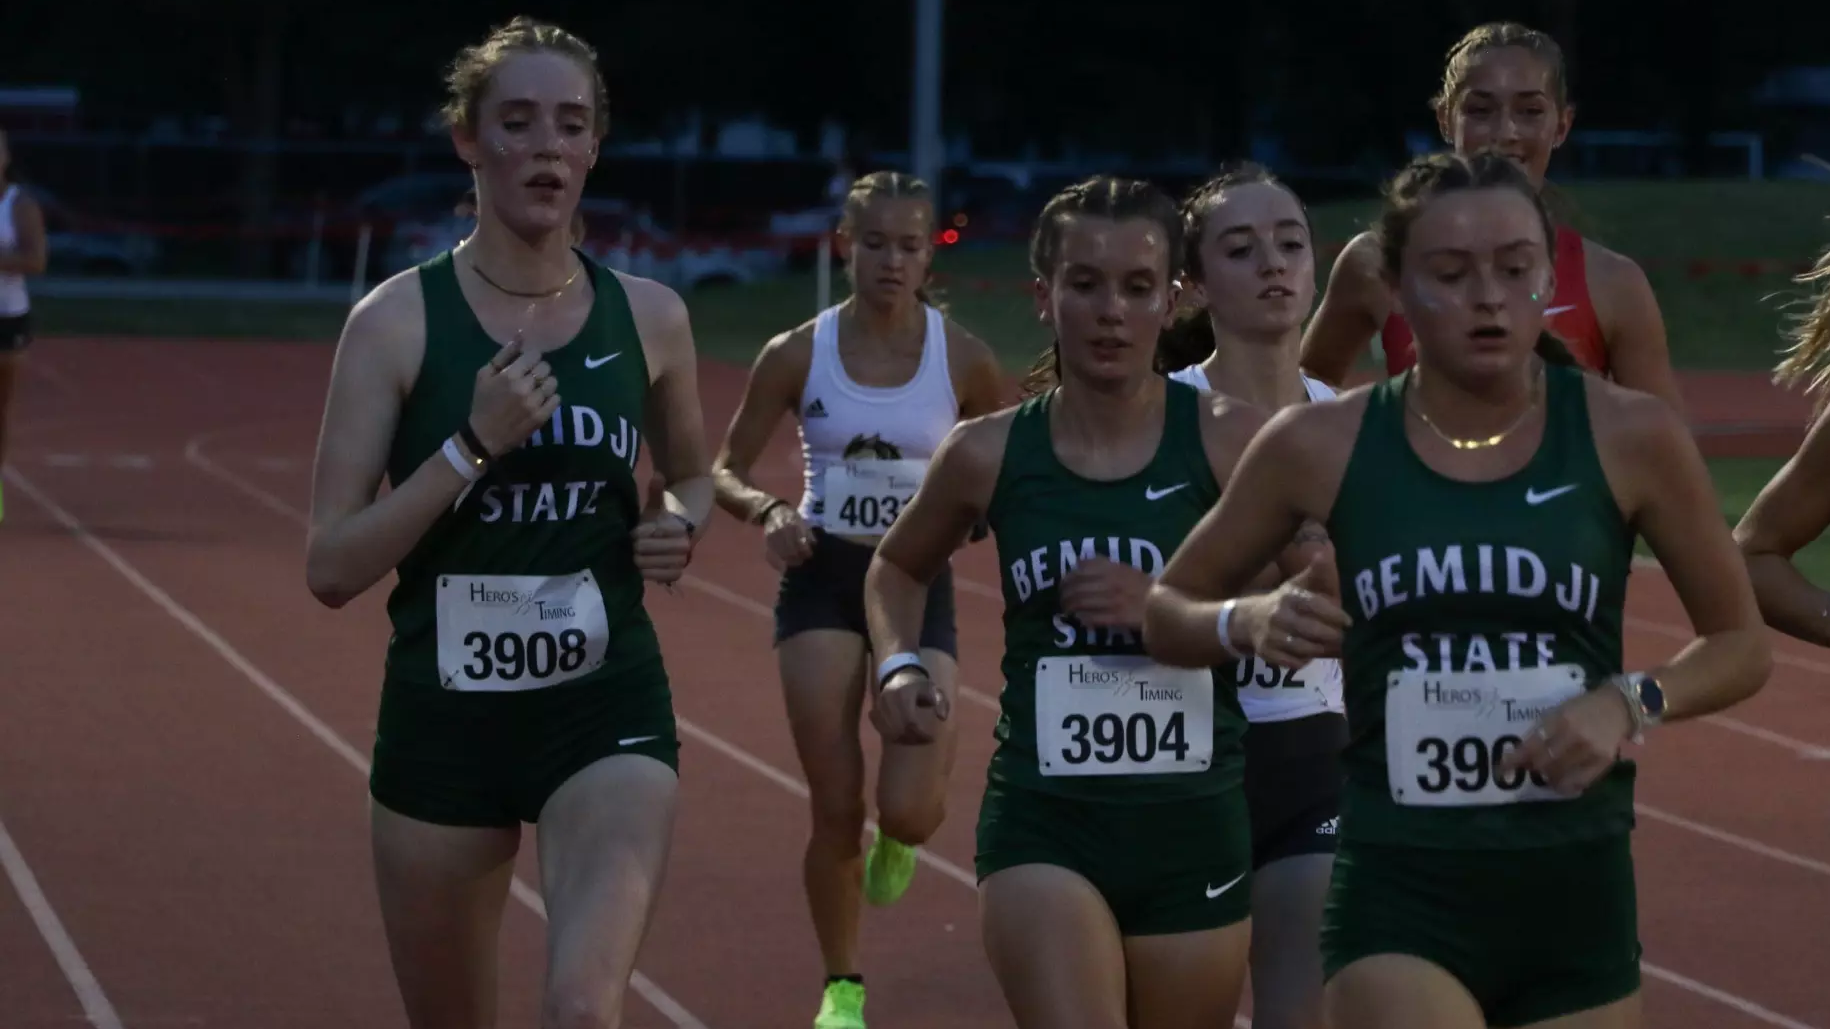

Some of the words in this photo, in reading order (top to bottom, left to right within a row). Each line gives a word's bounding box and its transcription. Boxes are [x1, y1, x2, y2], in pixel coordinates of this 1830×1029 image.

[839, 496, 912, 528] 403
[1011, 536, 1165, 603] BEMID
[1355, 544, 1600, 625] BEMIDJI
[535, 600, 576, 621] TIMING
[463, 628, 586, 681] 3908
[1402, 631, 1556, 673] STATE
[1135, 681, 1183, 702] TIMING
[1061, 711, 1189, 764] 3904
[1416, 734, 1548, 793] 390
